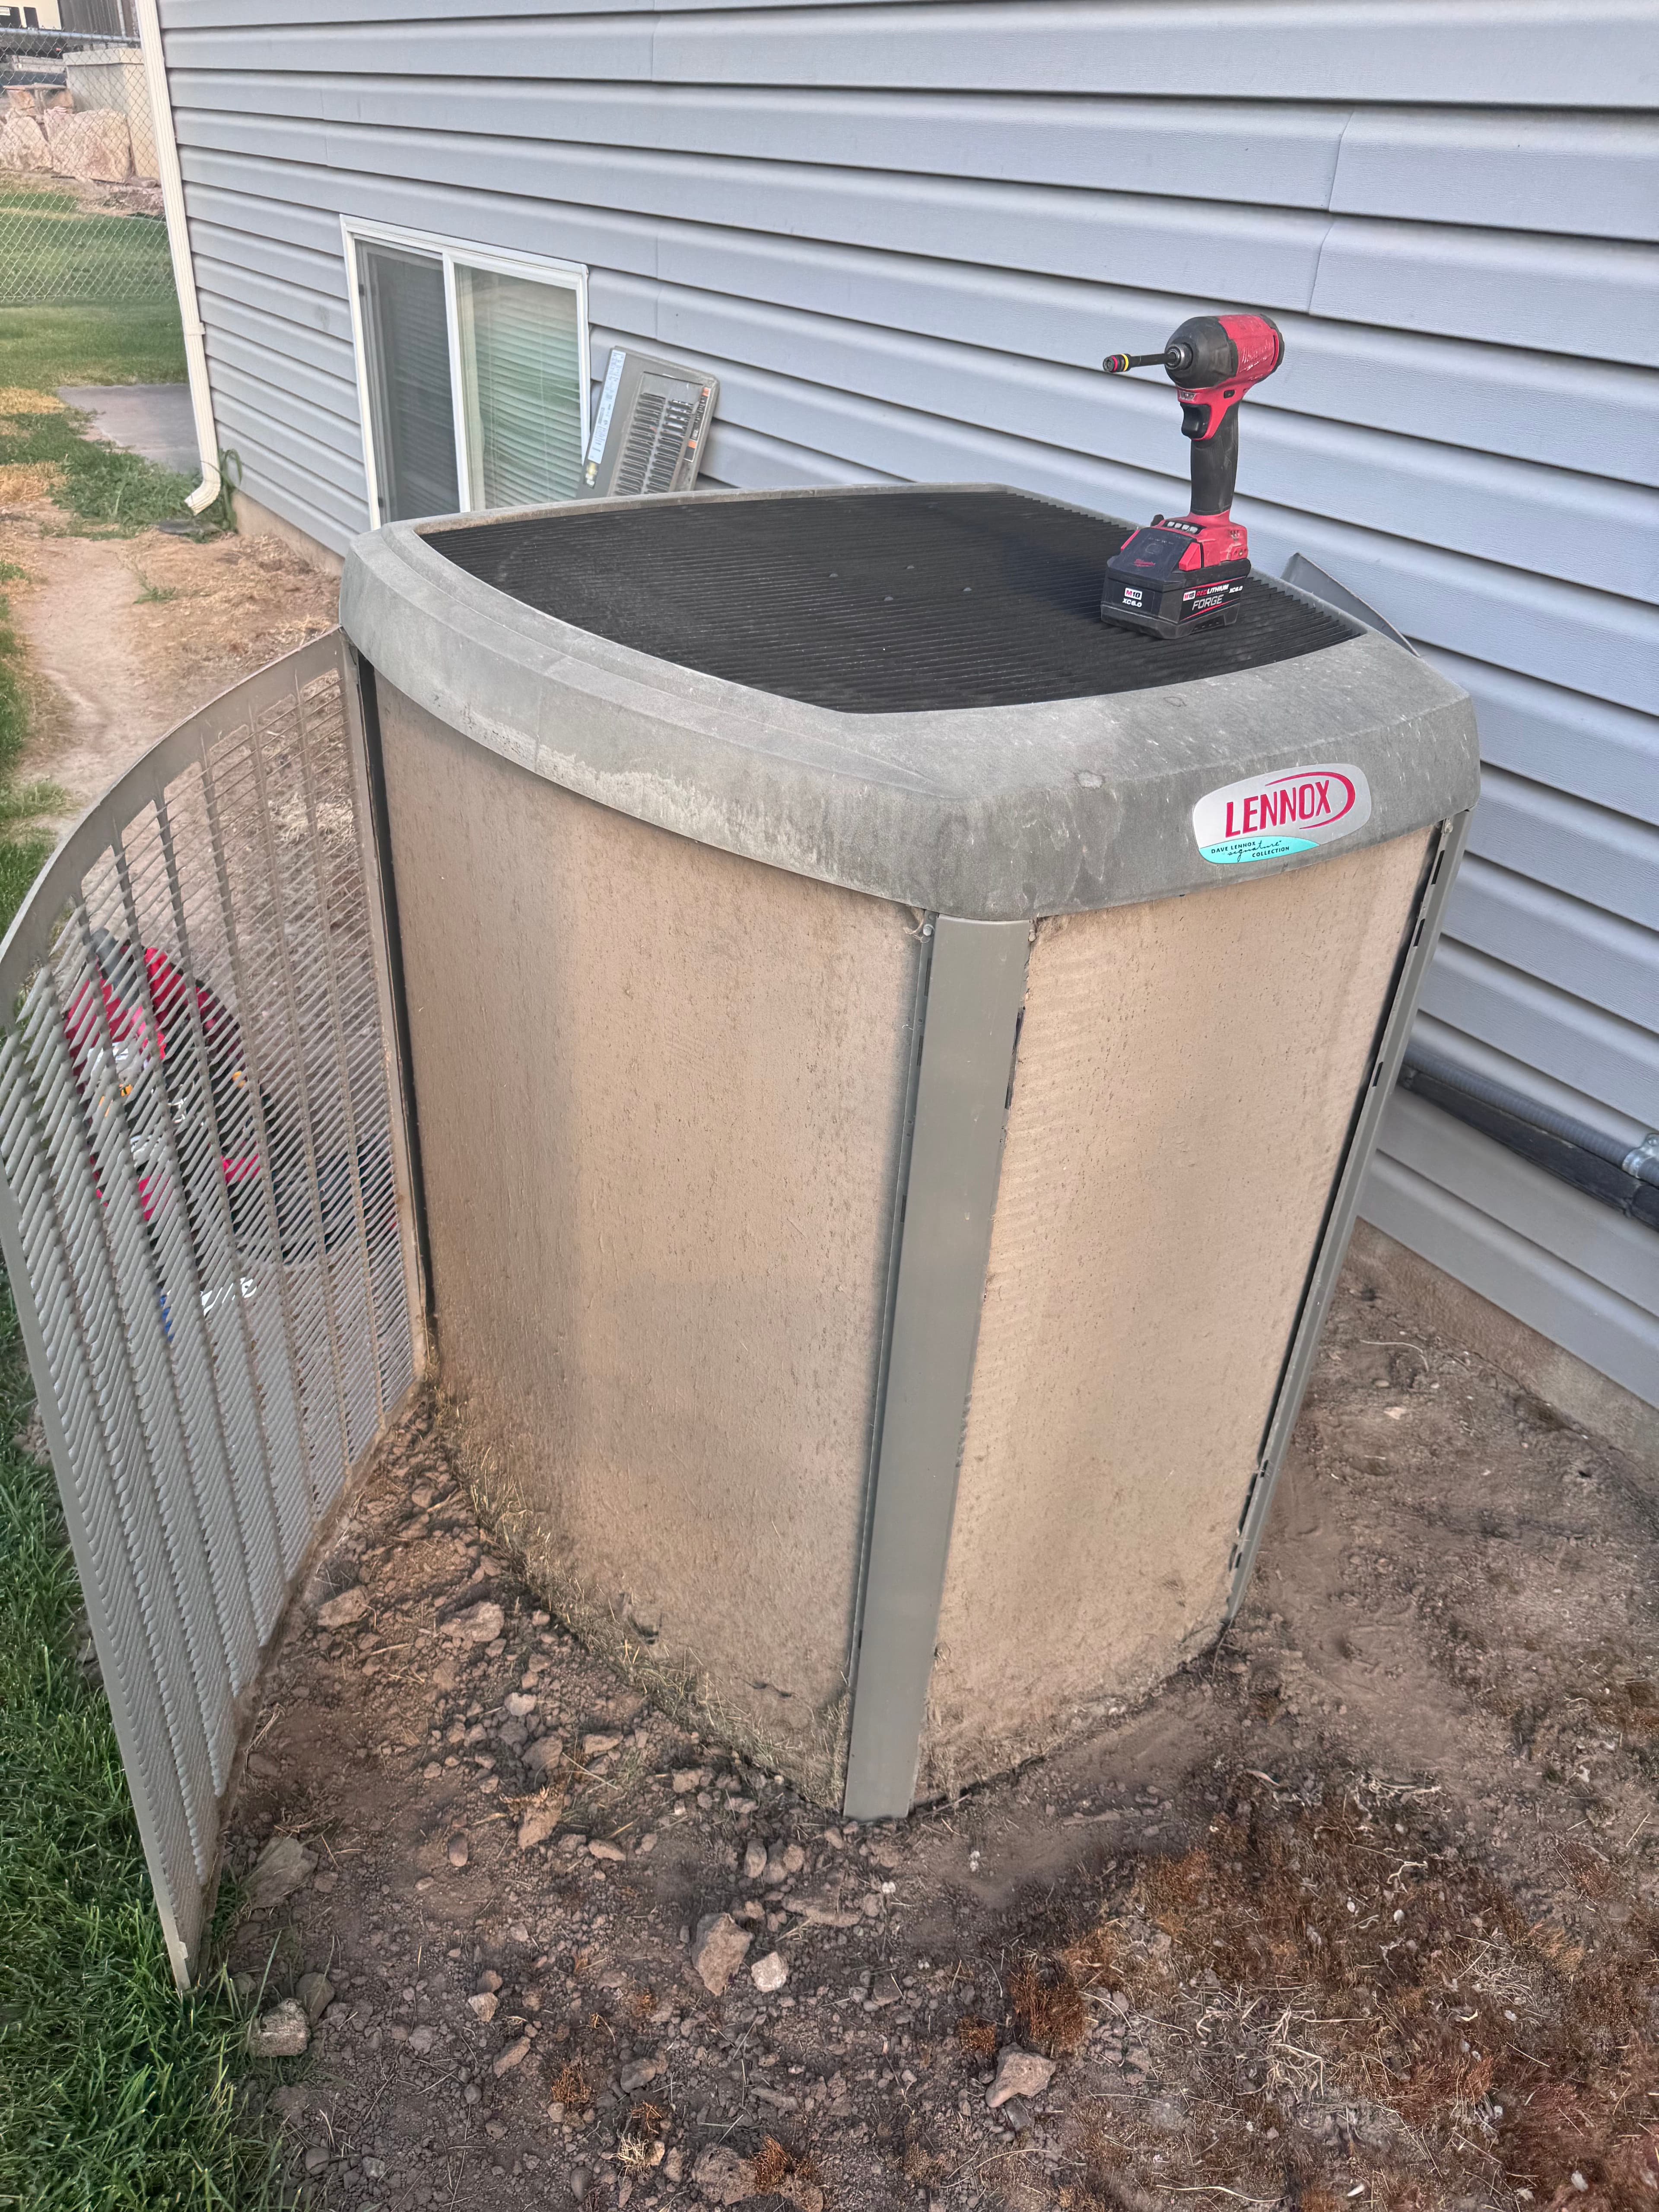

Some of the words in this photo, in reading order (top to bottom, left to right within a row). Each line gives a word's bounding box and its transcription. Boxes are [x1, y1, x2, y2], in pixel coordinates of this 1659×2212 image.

[1126, 590, 1141, 598] M18
[1196, 584, 1229, 597] REDLITHIUM
[1192, 594, 1224, 610] FORGE
[1225, 780, 1331, 838] LENNOX
[1227, 840, 1281, 862] signature
[1231, 842, 1255, 850] LENNOX
[1252, 846, 1290, 858] COLLECTION
